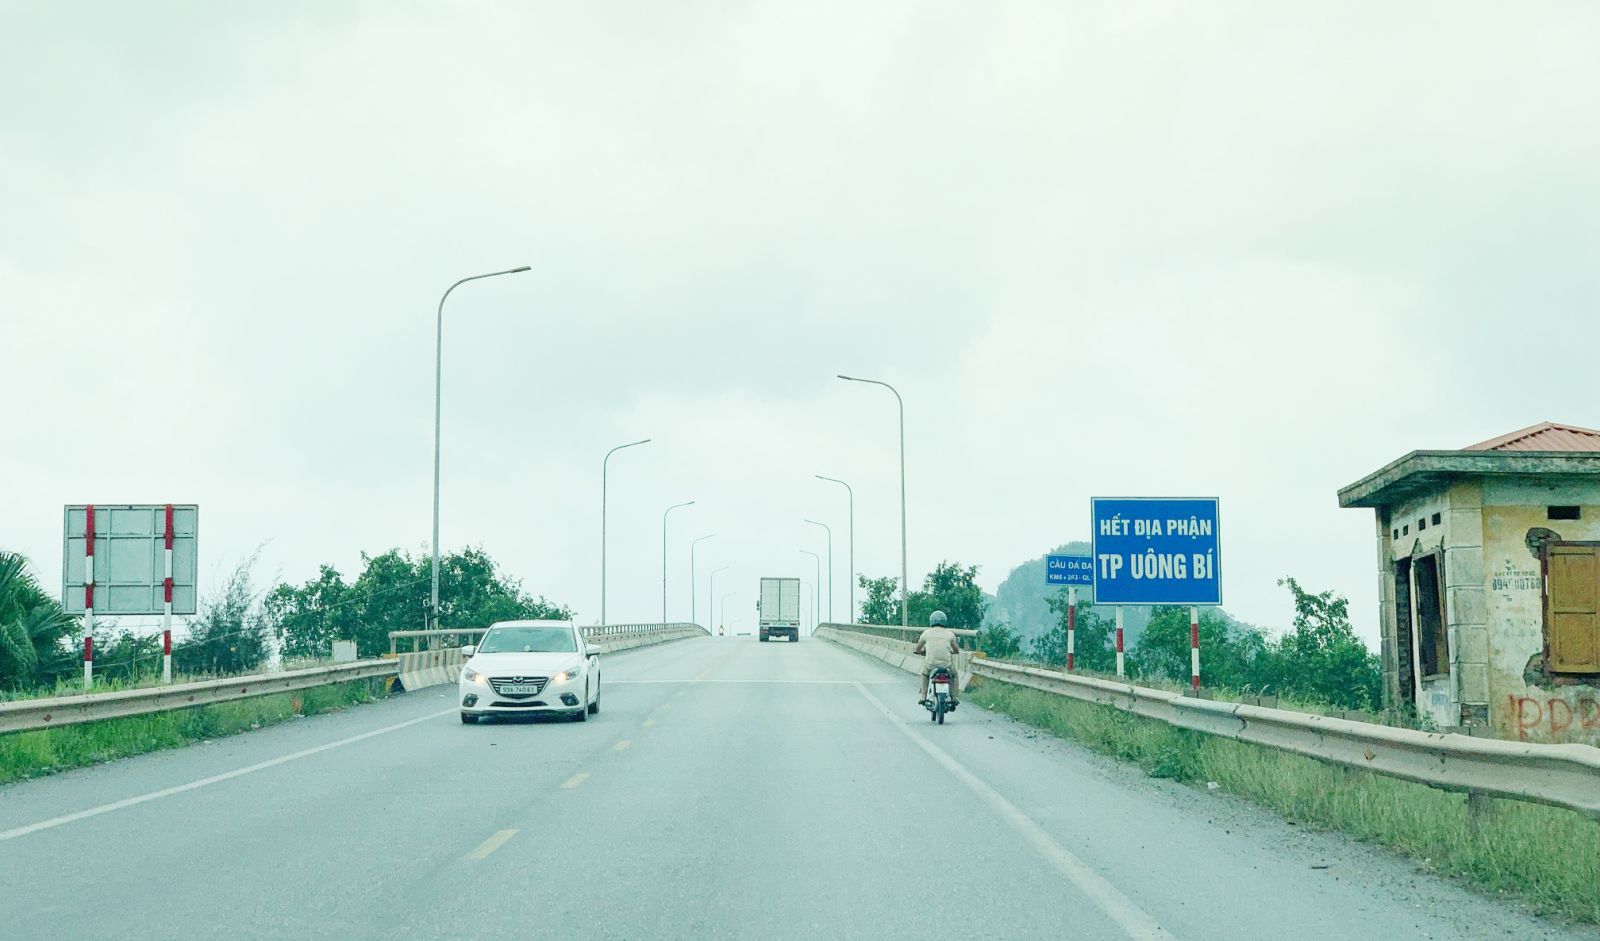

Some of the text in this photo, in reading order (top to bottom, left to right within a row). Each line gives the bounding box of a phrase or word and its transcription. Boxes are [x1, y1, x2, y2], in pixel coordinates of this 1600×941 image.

[1100, 513, 1212, 539] HẾT ĐỊA PHẬN
[1099, 548, 1213, 579] TP UÔNG BÍ
